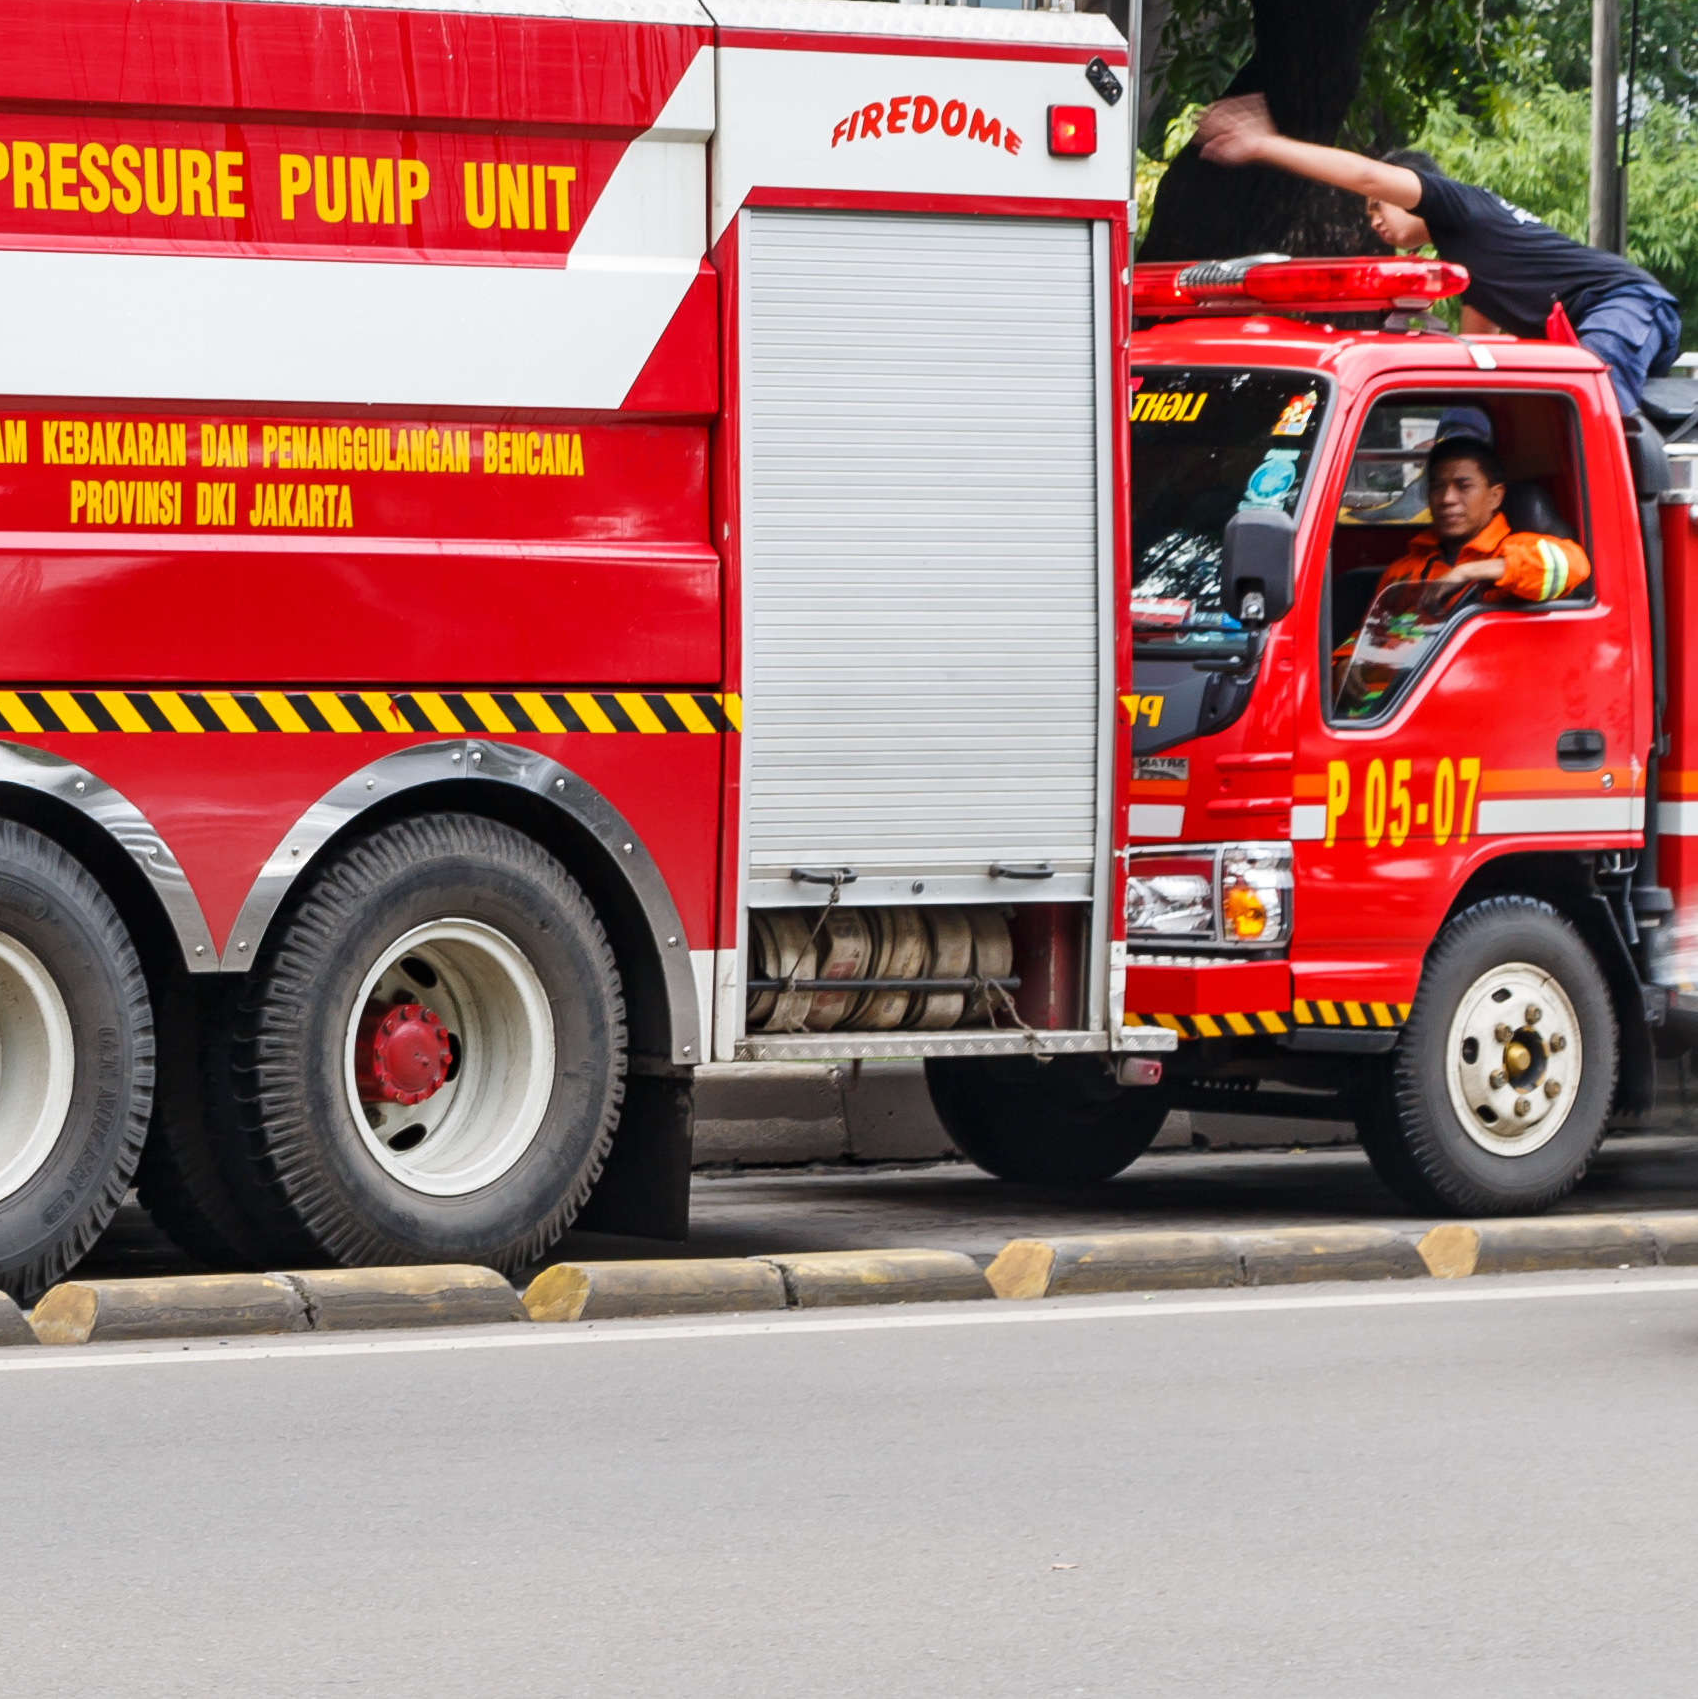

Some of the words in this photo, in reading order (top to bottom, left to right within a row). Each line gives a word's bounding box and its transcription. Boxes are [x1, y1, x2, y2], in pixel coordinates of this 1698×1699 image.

[831, 94, 1023, 157] FIREDOME
[280, 153, 431, 226] PUMP
[463, 161, 577, 232] UNIT
[42, 420, 187, 468] KEBAKARAN
[201, 423, 249, 470] DAN
[263, 425, 471, 475] PENANGGULANGAN
[483, 431, 585, 477] BENCANA
[69, 479, 183, 527] PROVINSI
[196, 482, 237, 528] DKI
[249, 482, 354, 530] JAKARTA
[1324, 760, 1351, 848] P
[1364, 757, 1482, 848] 05-07
